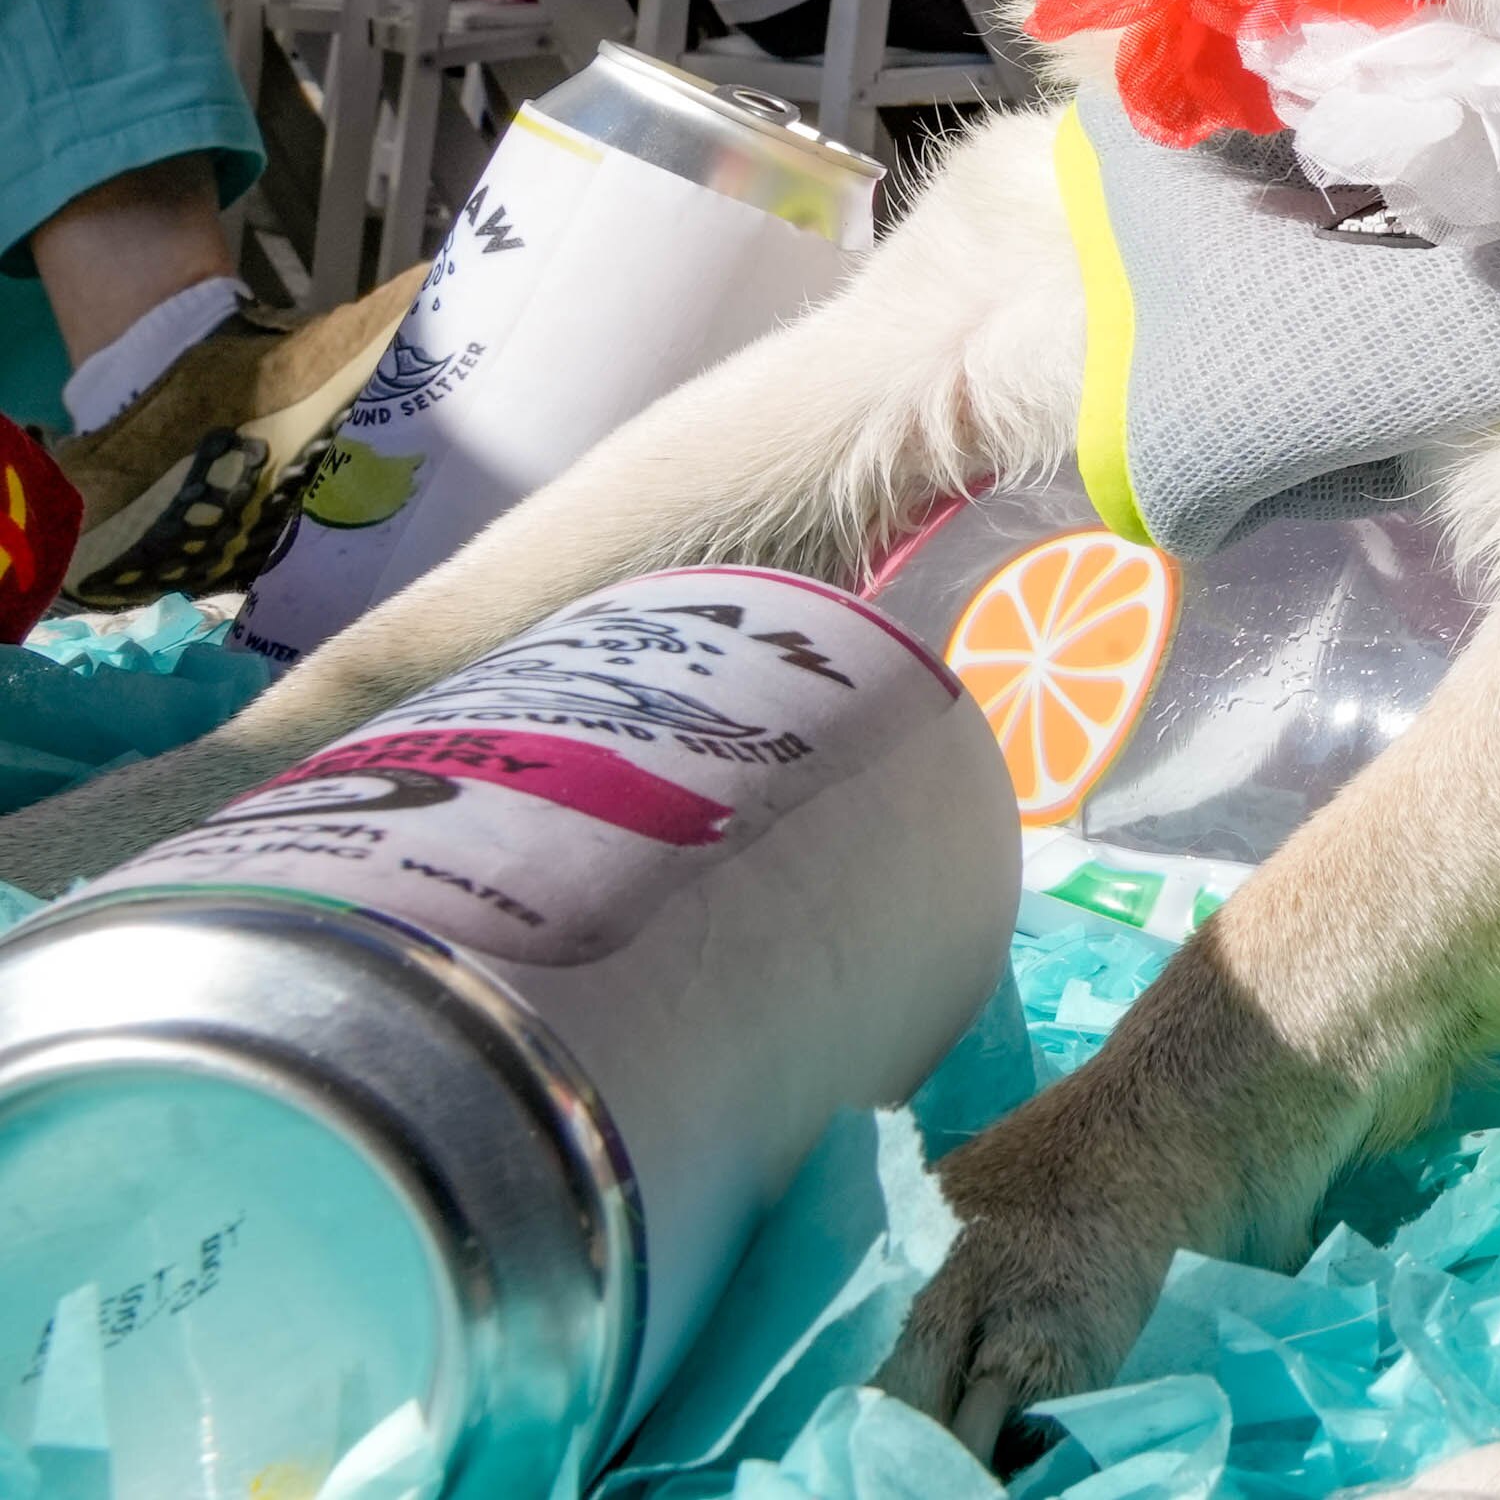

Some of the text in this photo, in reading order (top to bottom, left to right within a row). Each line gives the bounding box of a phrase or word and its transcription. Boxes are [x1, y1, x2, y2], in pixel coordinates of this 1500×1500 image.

[401, 342, 488, 416] SELTZER
[412, 711, 815, 764] HOUND SELTZER
